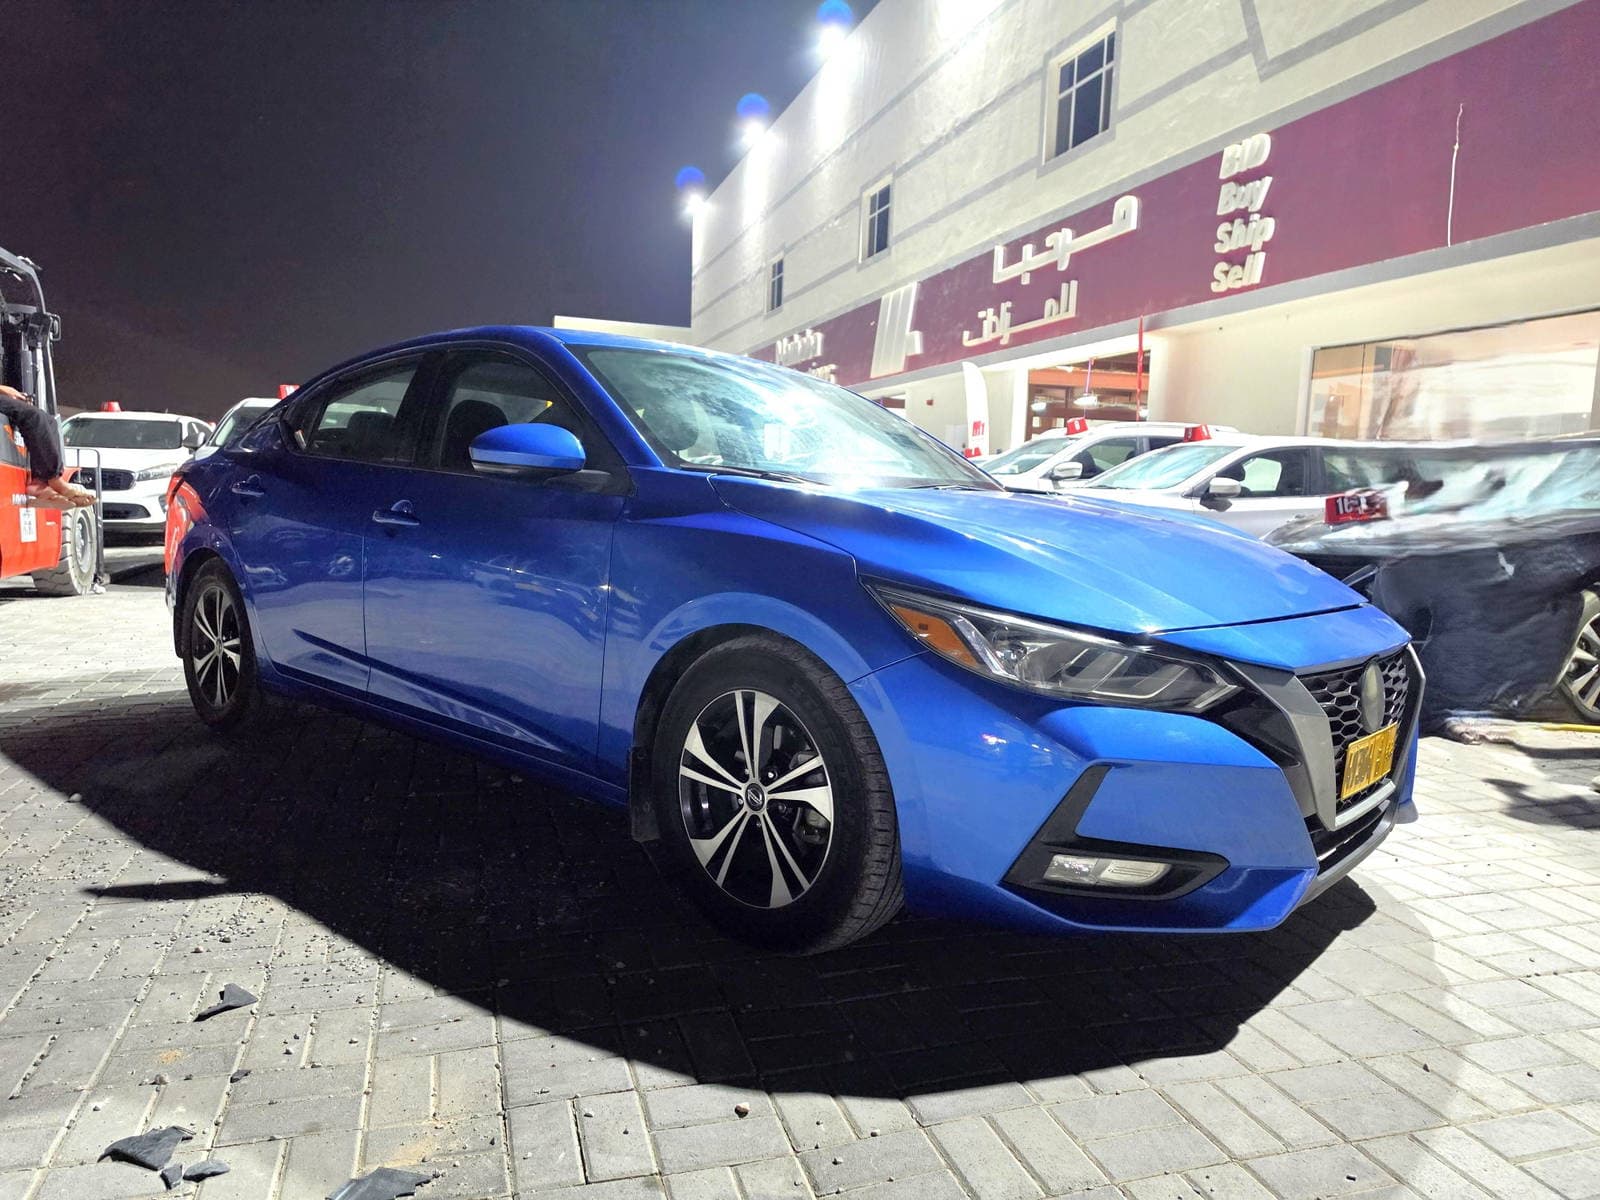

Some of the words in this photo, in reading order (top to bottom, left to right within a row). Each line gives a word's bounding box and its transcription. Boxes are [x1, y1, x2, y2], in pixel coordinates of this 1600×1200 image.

[1219, 133, 1271, 179] BID
[1216, 176, 1273, 215] Buy
[1214, 213, 1276, 253] Ship
[1210, 251, 1266, 292] Sell
